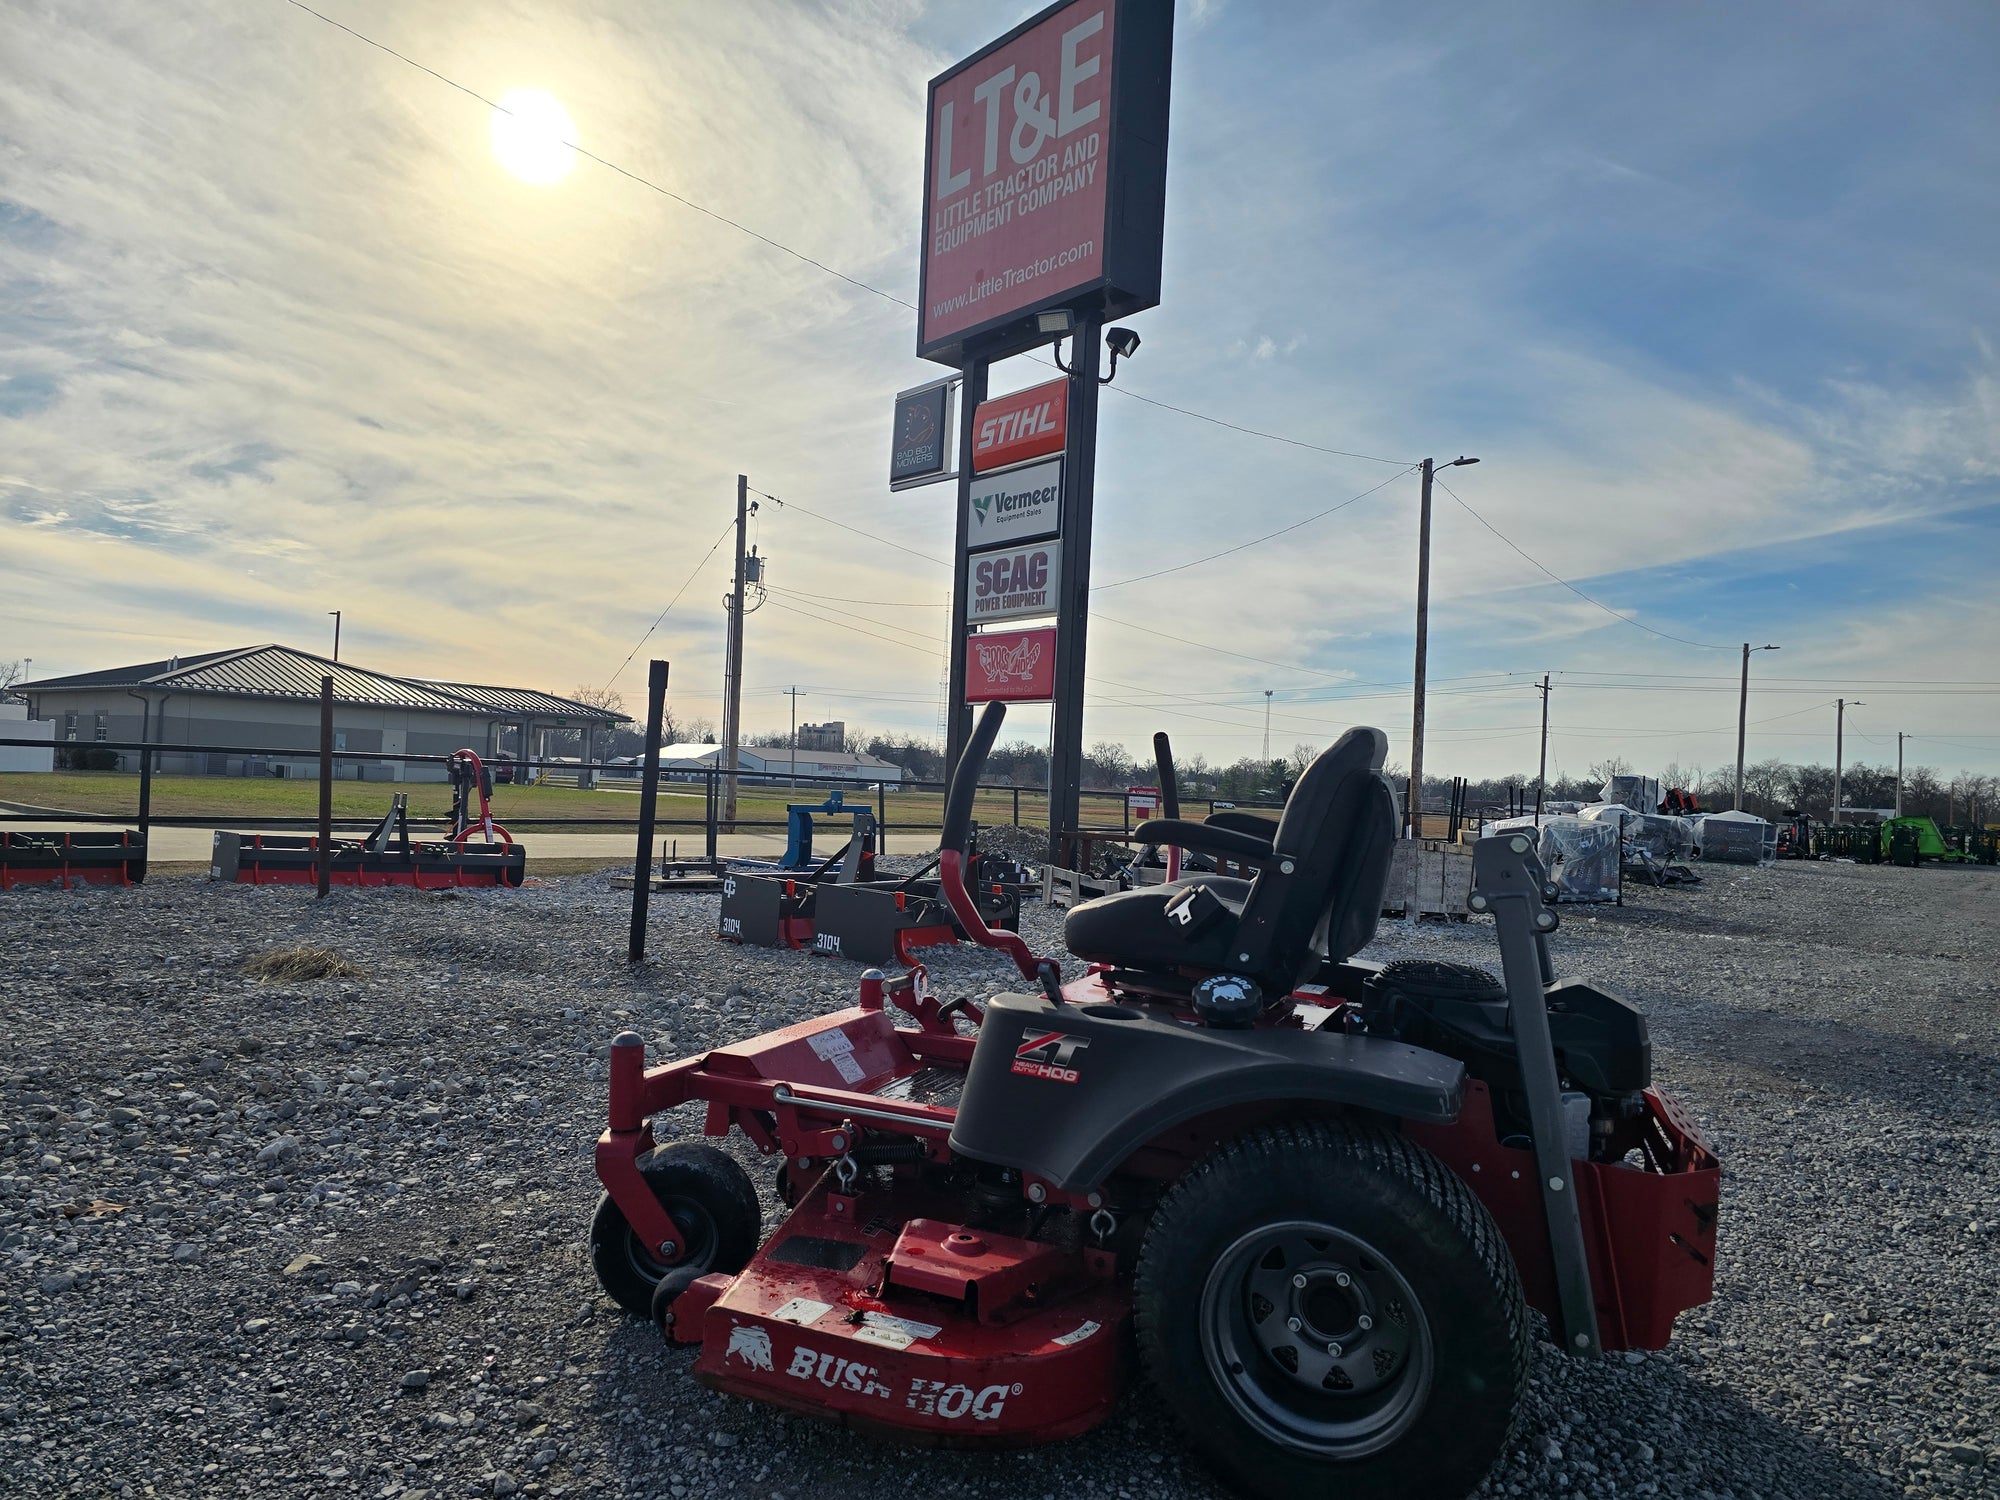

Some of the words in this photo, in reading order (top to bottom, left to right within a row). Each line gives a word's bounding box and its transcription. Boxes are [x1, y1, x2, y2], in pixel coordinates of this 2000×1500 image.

[937, 11, 1104, 200] LT&E
[935, 191, 981, 233] LITTLE
[985, 154, 1058, 208] TRACTOR
[1062, 133, 1099, 172] AND
[935, 199, 1014, 256] EQUIPMENT
[1018, 160, 1098, 217] COMPANY
[933, 240, 1094, 318] www.LittleTractor.com
[977, 401, 1056, 450] STIHL
[896, 450, 913, 460] BAD
[916, 444, 933, 455] BOY
[896, 453, 933, 468] MOWERS
[995, 486, 1057, 513] Vermeer
[996, 511, 1025, 523] Equipment
[1026, 509, 1042, 517] Sales
[976, 551, 1048, 597] SCAG
[975, 597, 1000, 613] POWER
[1002, 591, 1047, 609] EQUIPMENT
[723, 917, 741, 933] 3104
[817, 932, 841, 952] 3104
[1014, 1061, 1040, 1069] HEAVY
[1037, 1064, 1078, 1082] HOG
